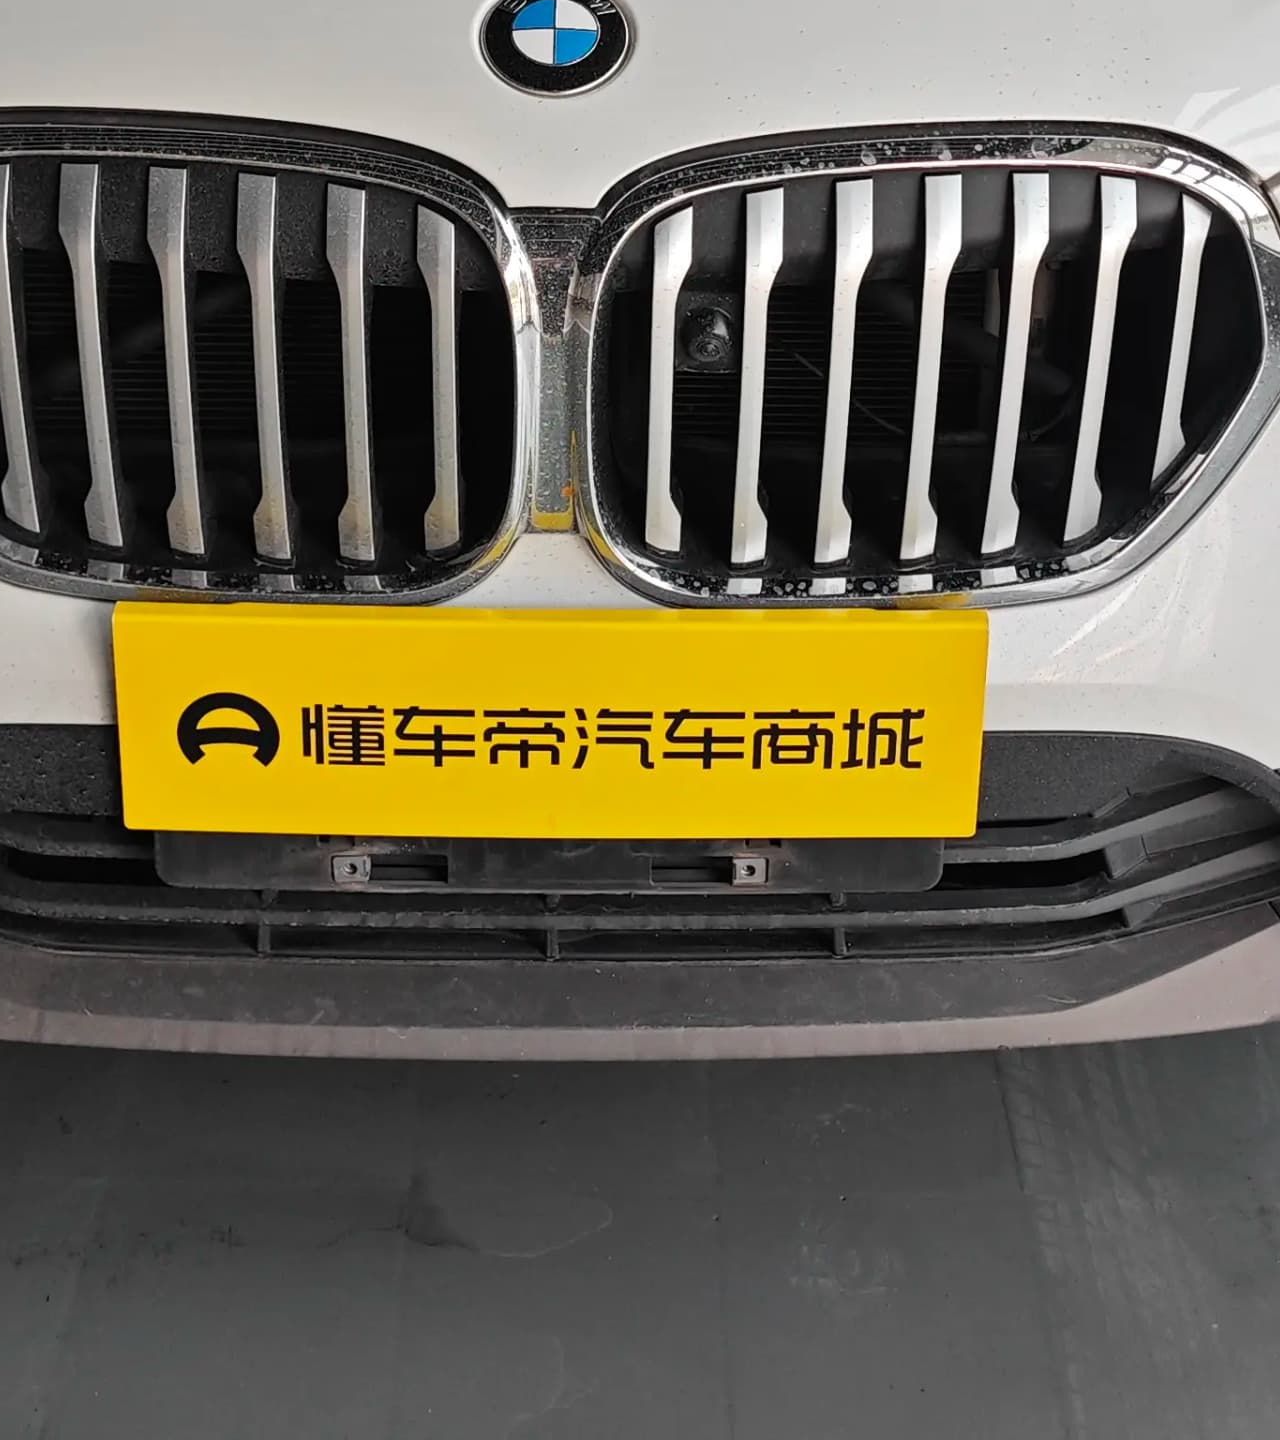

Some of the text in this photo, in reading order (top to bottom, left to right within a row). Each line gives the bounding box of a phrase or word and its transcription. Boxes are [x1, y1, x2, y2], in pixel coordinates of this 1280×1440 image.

[301, 703, 925, 770] 懂车帝汽车商城
